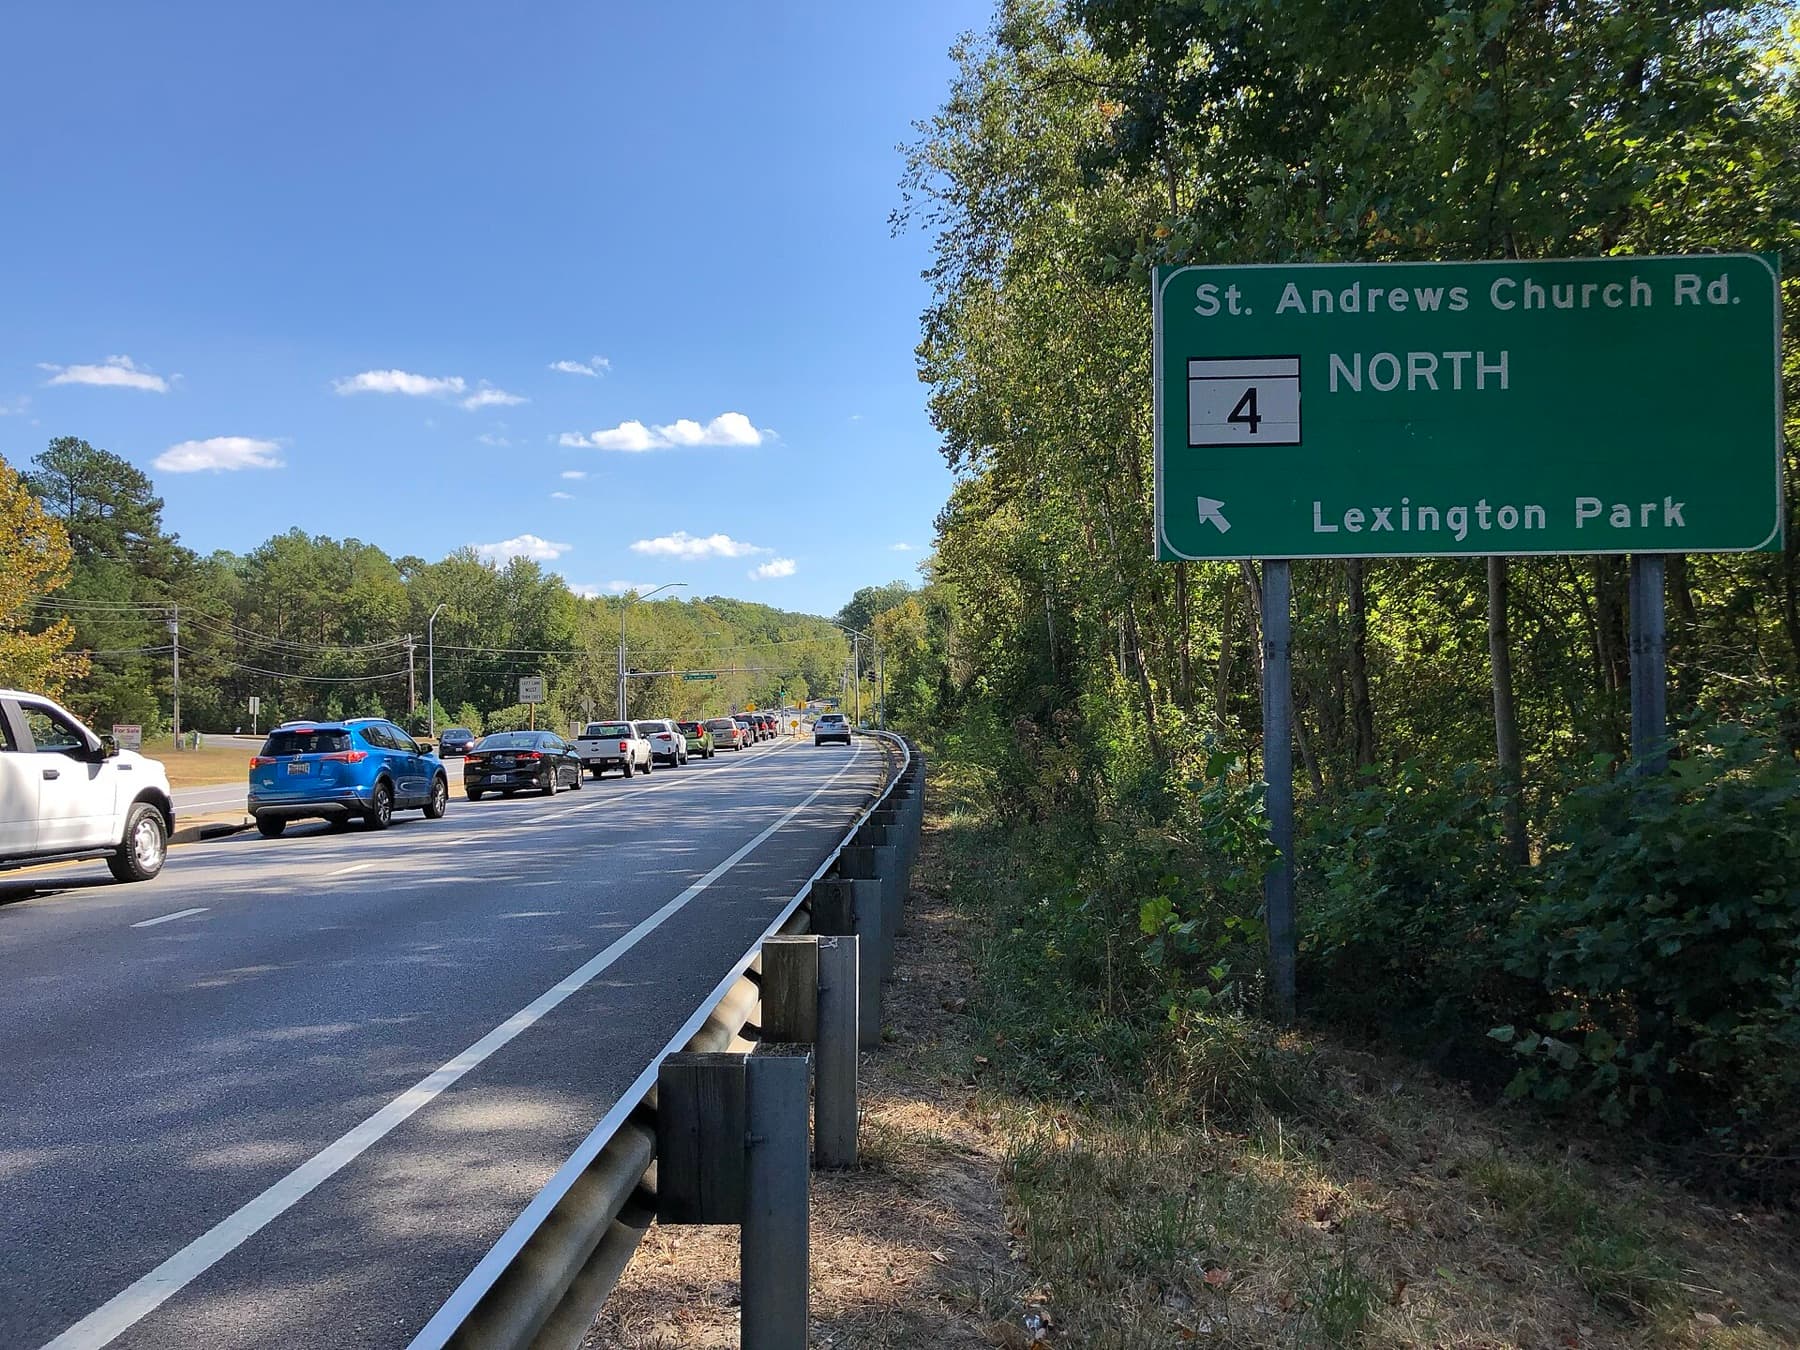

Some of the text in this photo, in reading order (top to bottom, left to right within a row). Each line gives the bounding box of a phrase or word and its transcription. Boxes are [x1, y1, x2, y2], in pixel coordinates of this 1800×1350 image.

[1194, 273, 1741, 317] St. Andrews Church Rd.
[1329, 350, 1510, 392] NORTH
[1227, 387, 1262, 434] 4
[1312, 496, 1686, 541] Lexington Park
